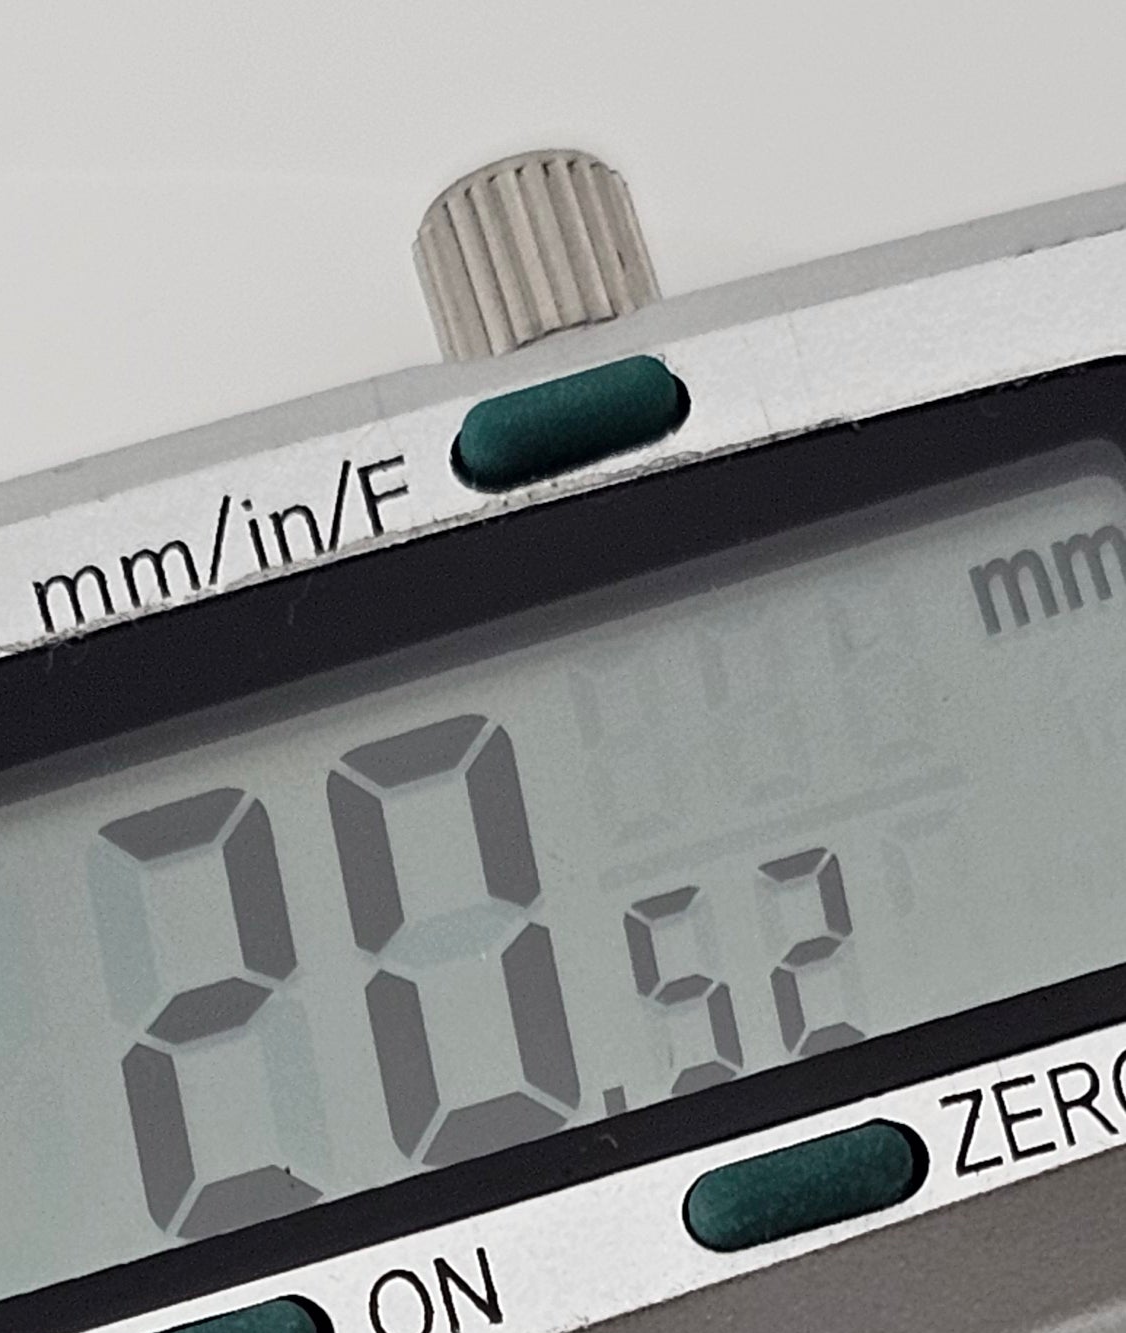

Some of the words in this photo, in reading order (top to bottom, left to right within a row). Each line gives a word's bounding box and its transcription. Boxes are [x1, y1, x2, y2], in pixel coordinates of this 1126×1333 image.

[32, 455, 410, 633] mm/in/F
[968, 524, 1126, 636] mm
[938, 1048, 1126, 1178] ZER
